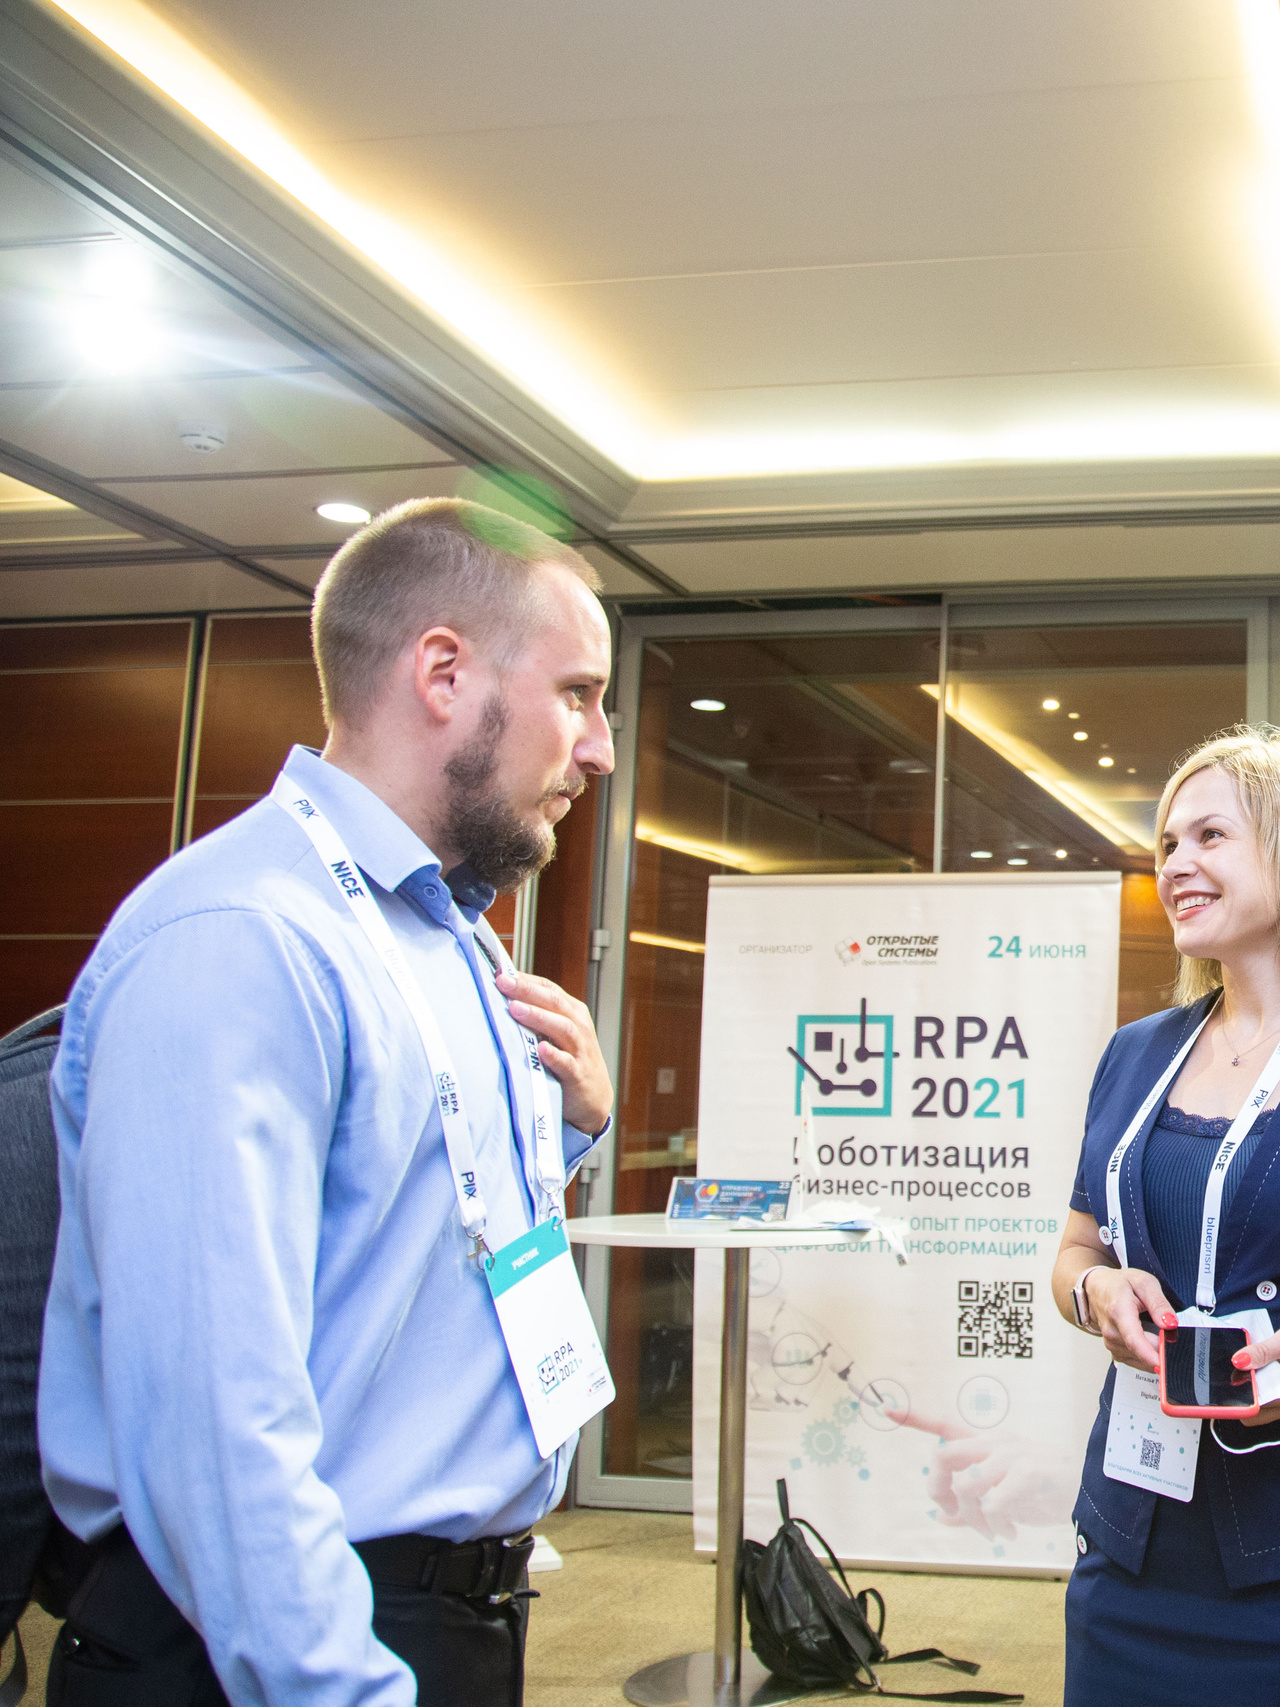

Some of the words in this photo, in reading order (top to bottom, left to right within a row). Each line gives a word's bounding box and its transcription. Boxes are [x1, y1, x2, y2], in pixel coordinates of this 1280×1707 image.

[292, 798, 320, 819] PIX
[330, 860, 366, 898] NICE
[738, 944, 813, 955] ОРГАНИЗАТОР
[866, 935, 939, 946] ОТКРЫТЫЕ
[987, 936, 1022, 958] 24
[1029, 944, 1087, 959] июня
[877, 947, 938, 958] СИСТЕМЫ
[914, 1016, 1029, 1059] RPA
[525, 1034, 542, 1072] NICE
[450, 1092, 459, 1115] RPA
[911, 1077, 1025, 1119] 2021
[1251, 1089, 1269, 1109] PIX
[536, 1114, 548, 1141] PIX
[1109, 1144, 1127, 1173] NICE
[1215, 1141, 1236, 1172] NICE
[461, 1171, 478, 1201] PIX
[778, 1182, 790, 1190] 23
[910, 1217, 960, 1232] ОПЫТ
[965, 1218, 1058, 1233] ПРОЕКТОВ
[1110, 1217, 1119, 1241] PIX
[553, 1341, 575, 1365] RPA
[559, 1358, 580, 1381] 2021
